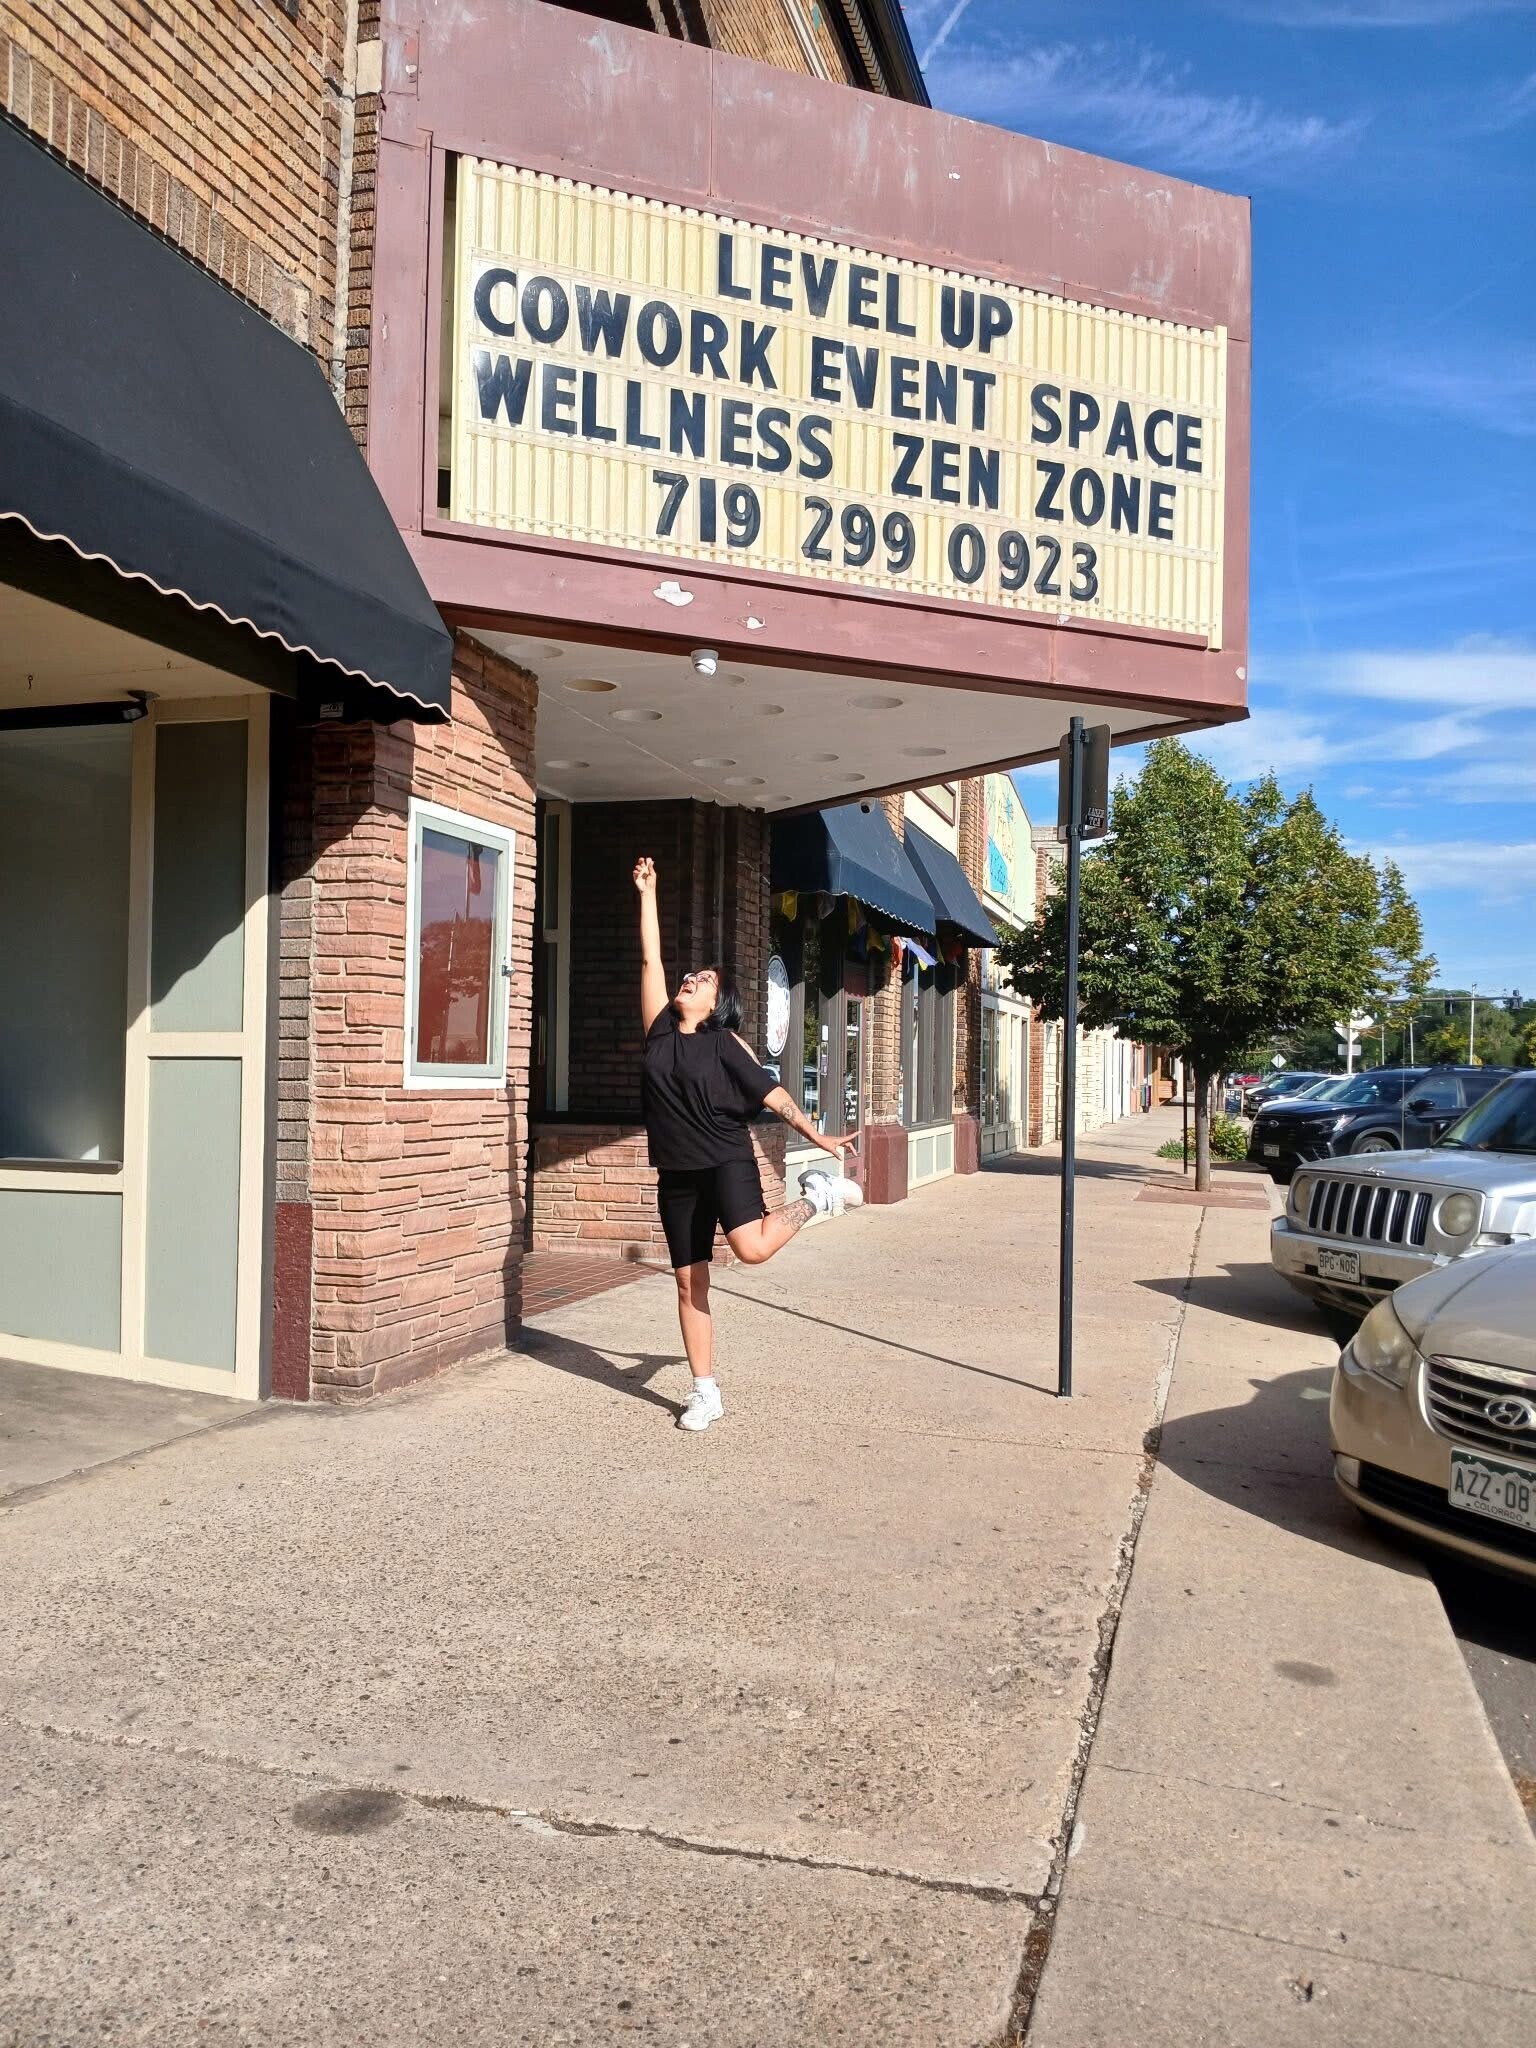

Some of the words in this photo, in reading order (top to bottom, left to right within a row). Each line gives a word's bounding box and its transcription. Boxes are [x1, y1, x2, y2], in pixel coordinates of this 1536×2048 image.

[718, 233, 916, 337] LEVEL
[940, 286, 1013, 354] UP
[474, 268, 778, 390] COWORK
[811, 336, 996, 431] EVENT
[1031, 384, 1203, 473] SPACE
[474, 351, 833, 480] WELLNESS
[892, 432, 1000, 510] ZEN
[1035, 460, 1176, 540] ZONE
[653, 470, 761, 548] 719
[802, 496, 916, 574] 299
[948, 524, 1099, 602] 0923
[1474, 1500, 1523, 1521] COLORADO
